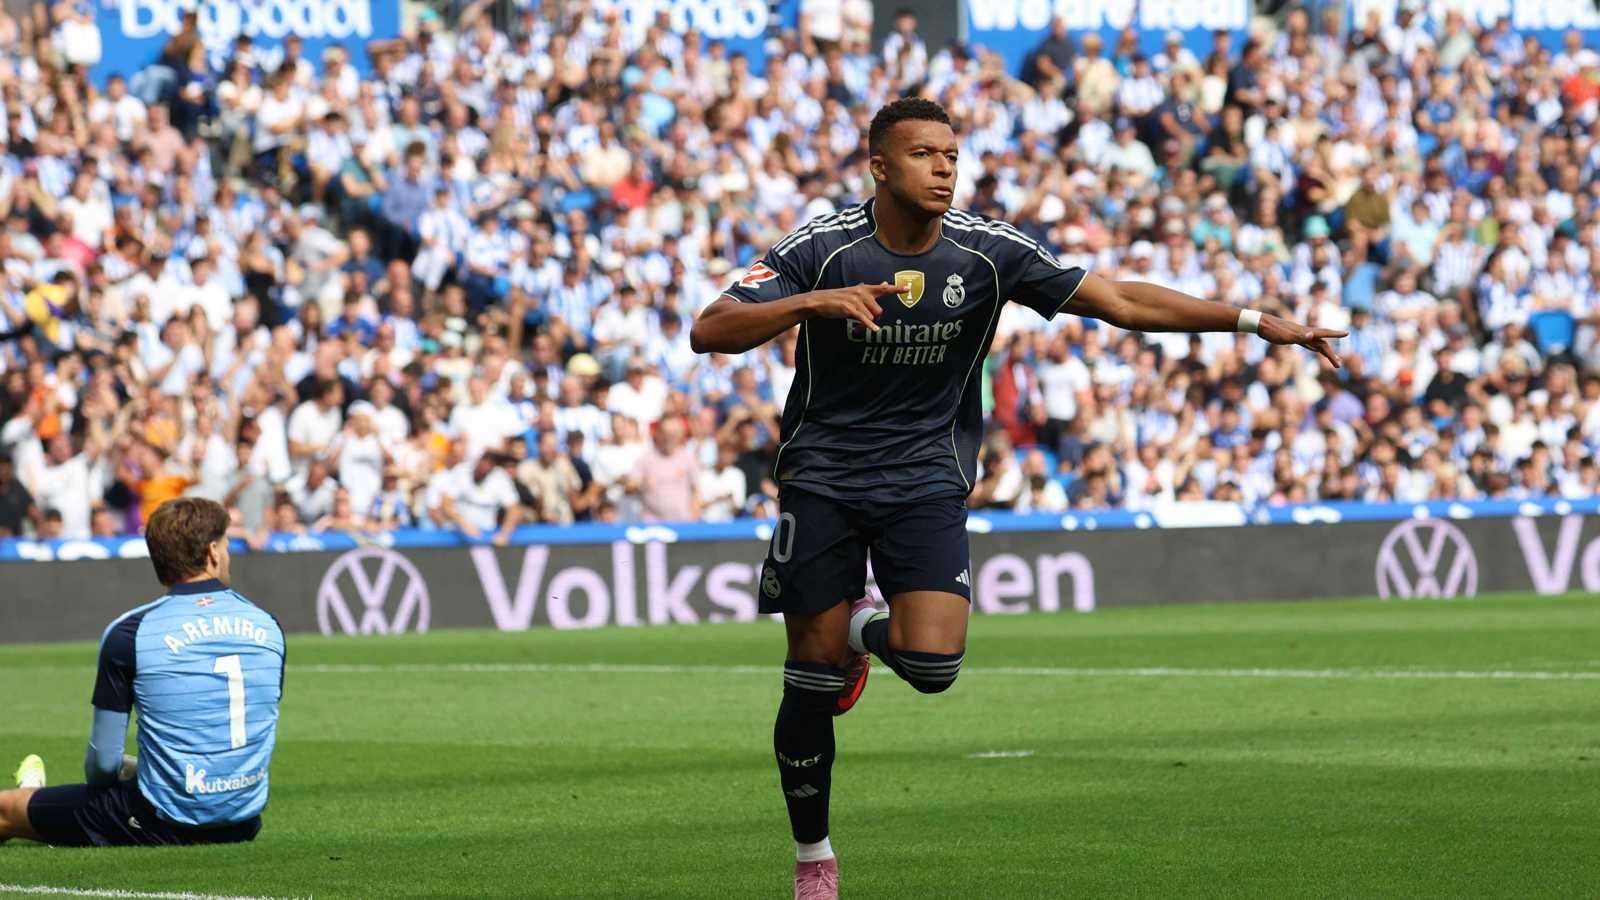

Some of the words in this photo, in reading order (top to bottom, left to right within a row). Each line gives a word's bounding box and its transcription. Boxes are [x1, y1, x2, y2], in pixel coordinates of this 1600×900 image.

[846, 319, 962, 344] Emirates
[861, 346, 889, 364] FLY
[892, 344, 947, 365] BETTER
[163, 615, 268, 655] A.REMIRO
[213, 653, 248, 751] 1
